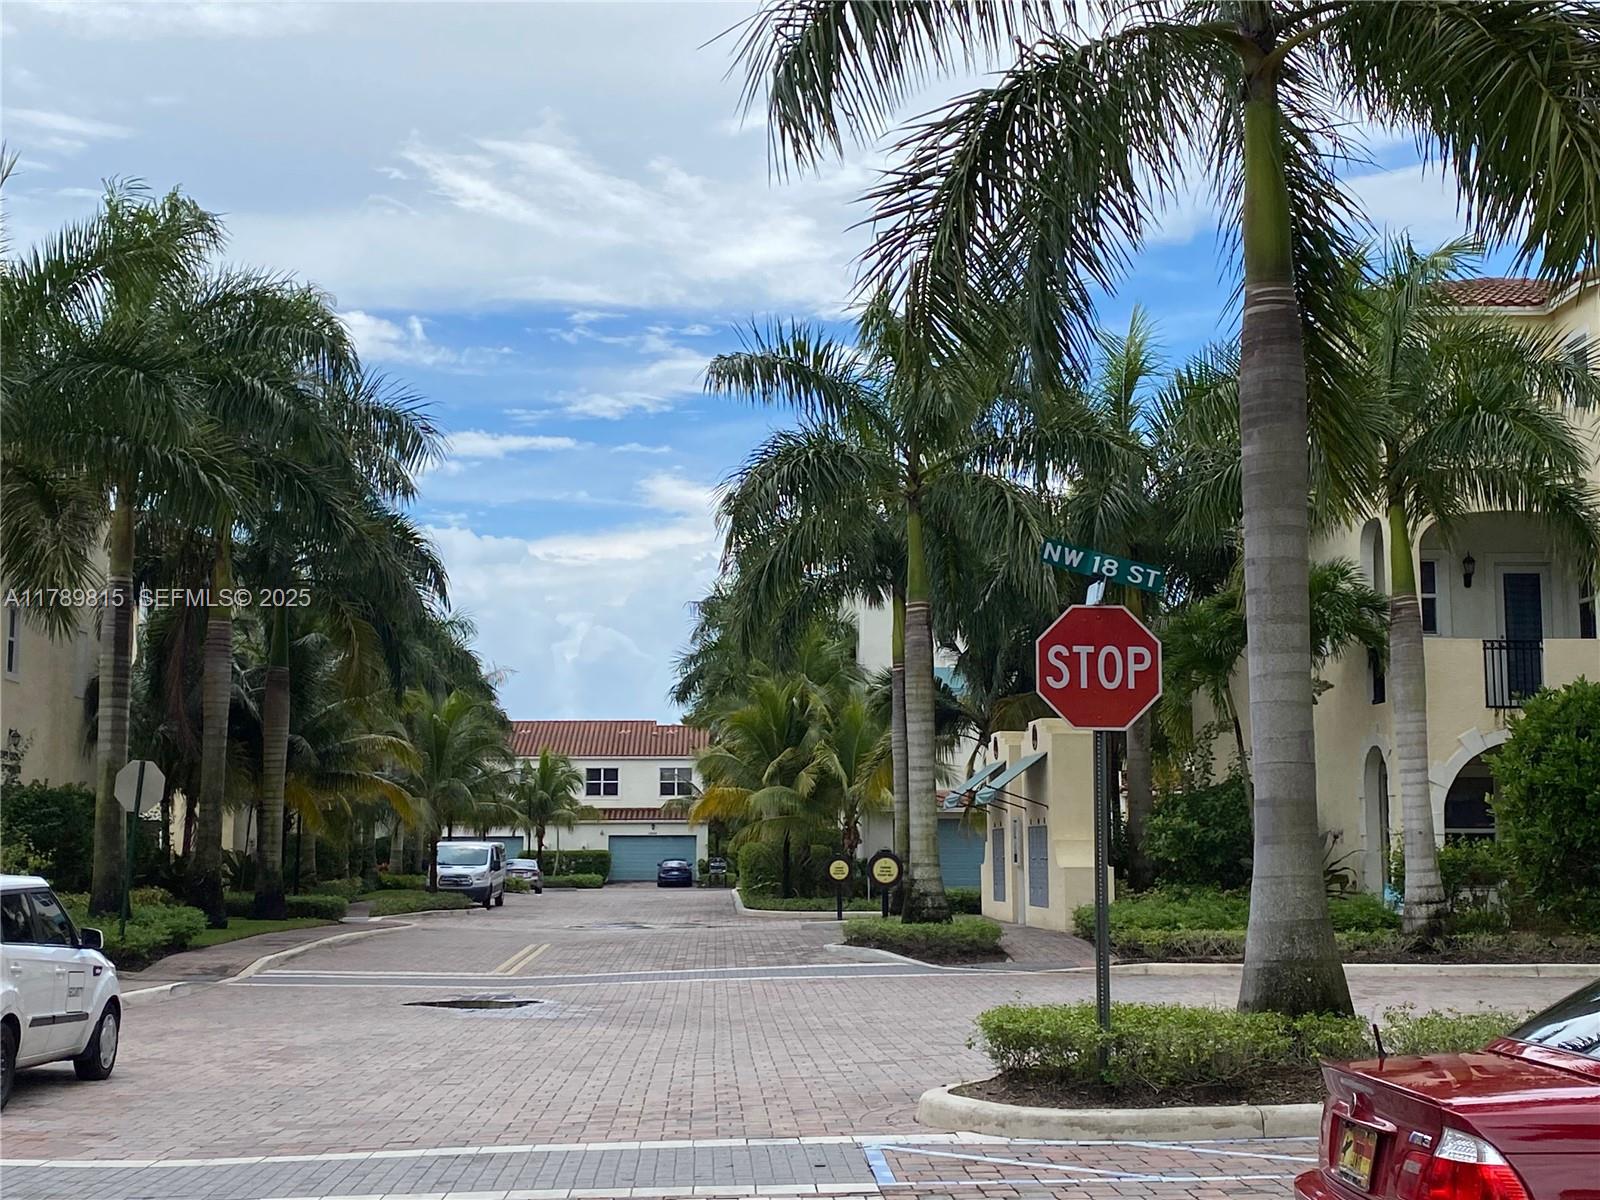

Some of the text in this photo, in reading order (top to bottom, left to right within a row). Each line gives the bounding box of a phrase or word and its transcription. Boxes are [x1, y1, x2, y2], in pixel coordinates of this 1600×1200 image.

[1043, 542, 1161, 588] NW 18 ST
[1046, 644, 1152, 690] STOP
